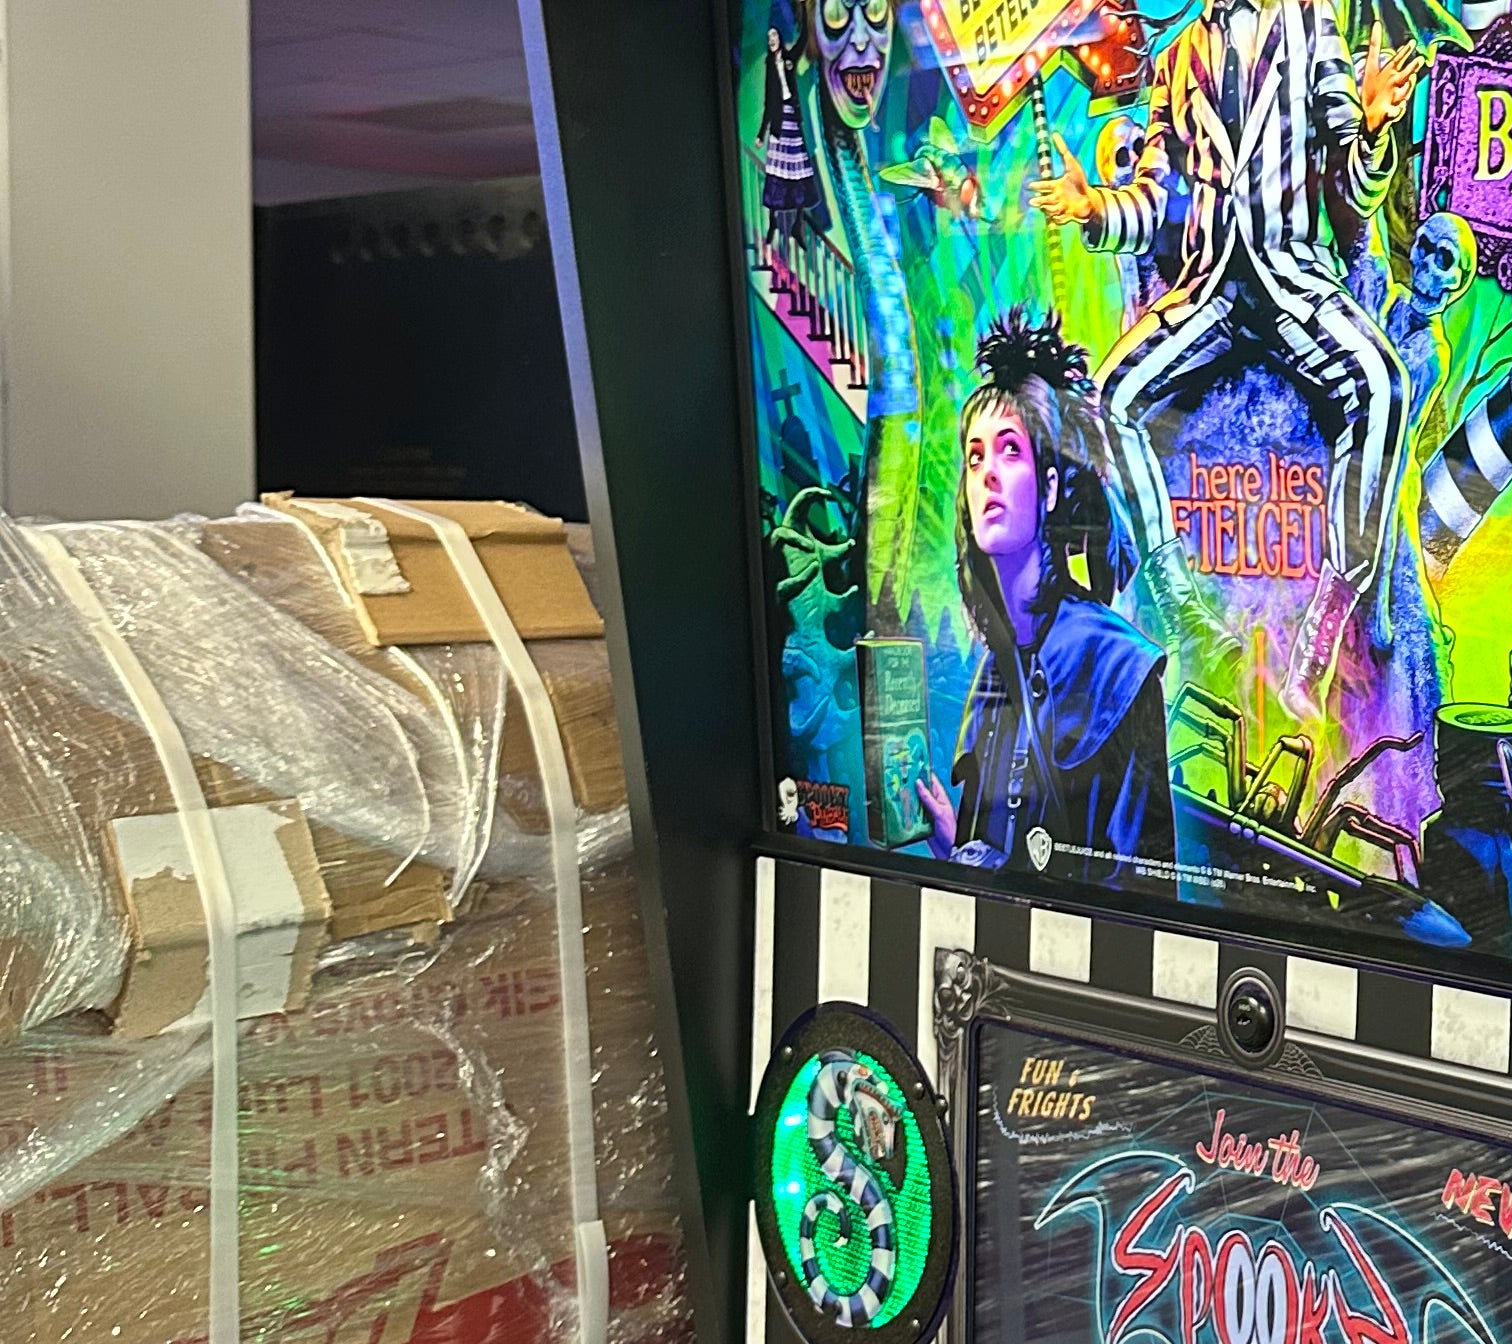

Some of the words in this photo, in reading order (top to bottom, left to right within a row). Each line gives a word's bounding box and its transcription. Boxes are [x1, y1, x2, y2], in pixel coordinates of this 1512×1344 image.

[1191, 453, 1262, 501] here
[1269, 452, 1324, 504] lies
[1020, 1056, 1061, 1088] FUN
[1006, 1088, 1096, 1122] FRIGHTS
[1195, 1108, 1264, 1172] Join
[1268, 1134, 1320, 1191] the
